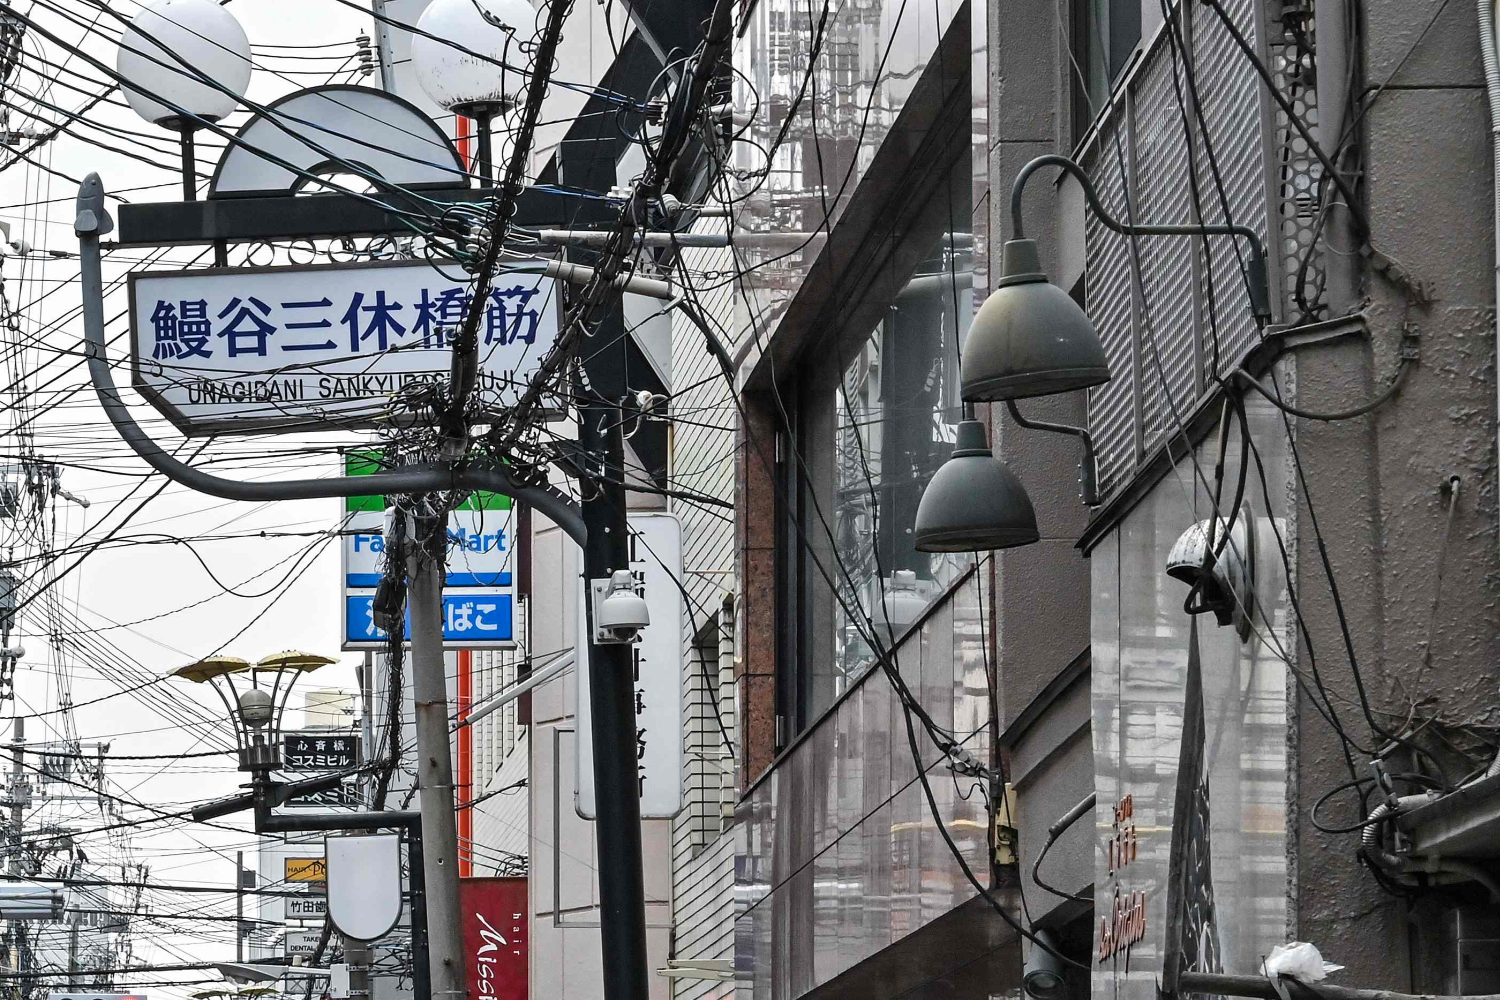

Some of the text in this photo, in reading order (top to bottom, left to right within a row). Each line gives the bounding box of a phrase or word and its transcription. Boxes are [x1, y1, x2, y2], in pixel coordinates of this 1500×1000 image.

[188, 377, 304, 404] UNAGIDANI
[353, 527, 506, 553] FaMart
[513, 912, 522, 956] hair
